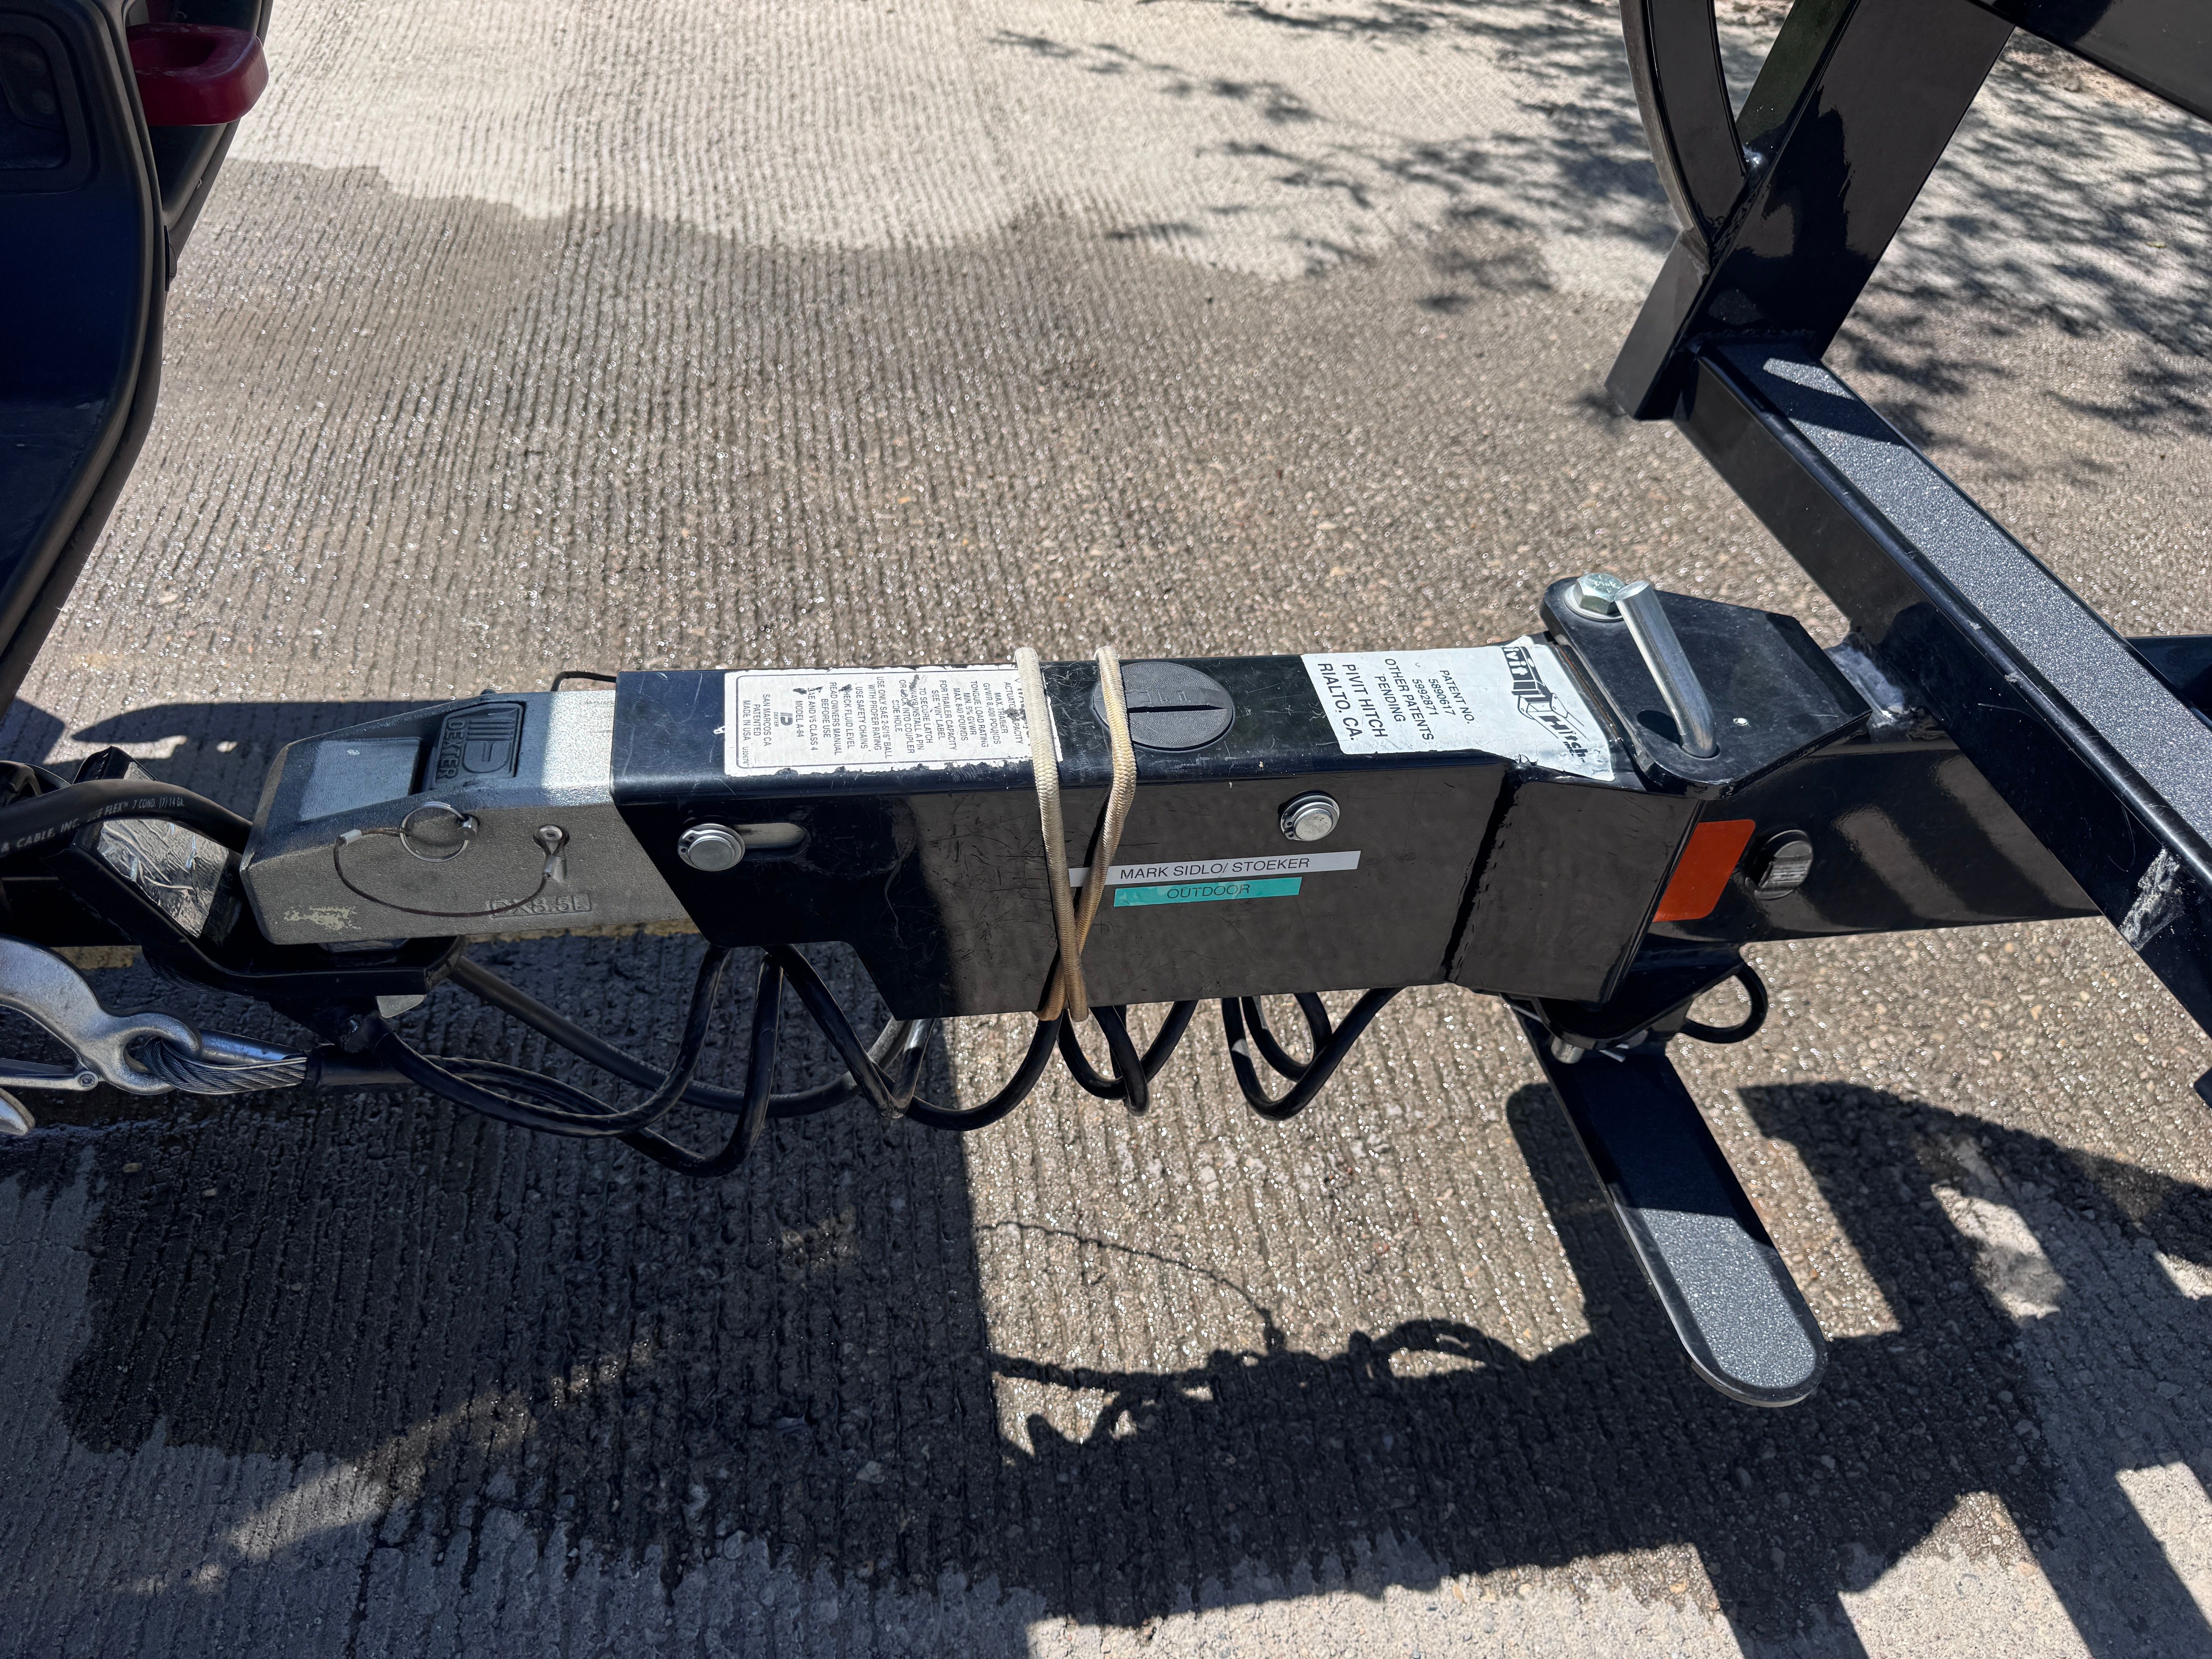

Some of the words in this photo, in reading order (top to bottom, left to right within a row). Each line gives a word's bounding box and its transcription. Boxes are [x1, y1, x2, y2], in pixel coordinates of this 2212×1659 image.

[830, 682, 838, 698] READ
[868, 684, 876, 699] WITH
[899, 680, 907, 688] OR
[939, 680, 948, 692] FOR
[970, 681, 981, 705] TONGUE
[983, 683, 993, 700] GVWR
[842, 687, 852, 708] HECK
[878, 690, 886, 705] ONLY
[892, 700, 900, 713] SIDE
[942, 693, 952, 718] TRAILER
[963, 693, 972, 705] MIN.
[994, 693, 1003, 707] MAX.
[1342, 665, 1368, 694] PIVIT
[1358, 699, 1388, 737] HITCH
[1374, 677, 1406, 721] PENDING
[1385, 659, 1410, 691] OTHER
[1402, 695, 1434, 740] PATENTS
[1412, 679, 1439, 714] 5992871
[1428, 679, 1456, 715] 5890617
[1439, 670, 1466, 704] PATENT
[1460, 708, 1474, 724] NO.
[795, 701, 804, 722] MODEL
[821, 699, 830, 723] BEFORE
[831, 700, 840, 726] OWNERS
[845, 709, 853, 727] FLUID
[857, 700, 866, 723] SAFETY
[870, 701, 879, 725] PROPER
[880, 707, 888, 718] SAE
[902, 708, 911, 721] INTO
[912, 707, 921, 731] INSTALL
[920, 697, 930, 721] SECURE
[932, 690, 940, 702] SEE
[936, 720, 945, 740] LABEL
[953, 688, 962, 702] MAX.
[958, 715, 968, 740] POUNDS
[966, 706, 973, 715] 5%
[975, 707, 984, 723] LOAD
[986, 702, 995, 716] 8,400
[1004, 682, 1016, 709] ACTUATO
[1011, 716, 1023, 744] PACITY
[796, 724, 804, 737] A-84
[894, 716, 902, 732] HOLE
[967, 716, 977, 735] GVWR
[997, 708, 1008, 733] TRAILER
[1343, 718, 1362, 740] CA.
[764, 737, 771, 746] CA
[810, 725, 818, 745] CLASS
[833, 728, 842, 755] MANUAL
[846, 729, 855, 749] LEVEL
[859, 725, 868, 748] CHAINS
[872, 727, 881, 750] RATING
[905, 723, 915, 753] COUPLER
[924, 723, 933, 743] LATCH
[946, 720, 957, 750] CAPACITY
[978, 725, 988, 747] RATING
[989, 719, 1001, 744] POUNDS
[436, 721, 467, 779] DEXTER
[884, 742, 892, 759] BALL
[916, 740, 924, 750] PIN
[1120, 867, 1168, 879] MARK
[1232, 858, 1310, 872] STOEKER
[1167, 884, 1250, 899] OUTDOOR
